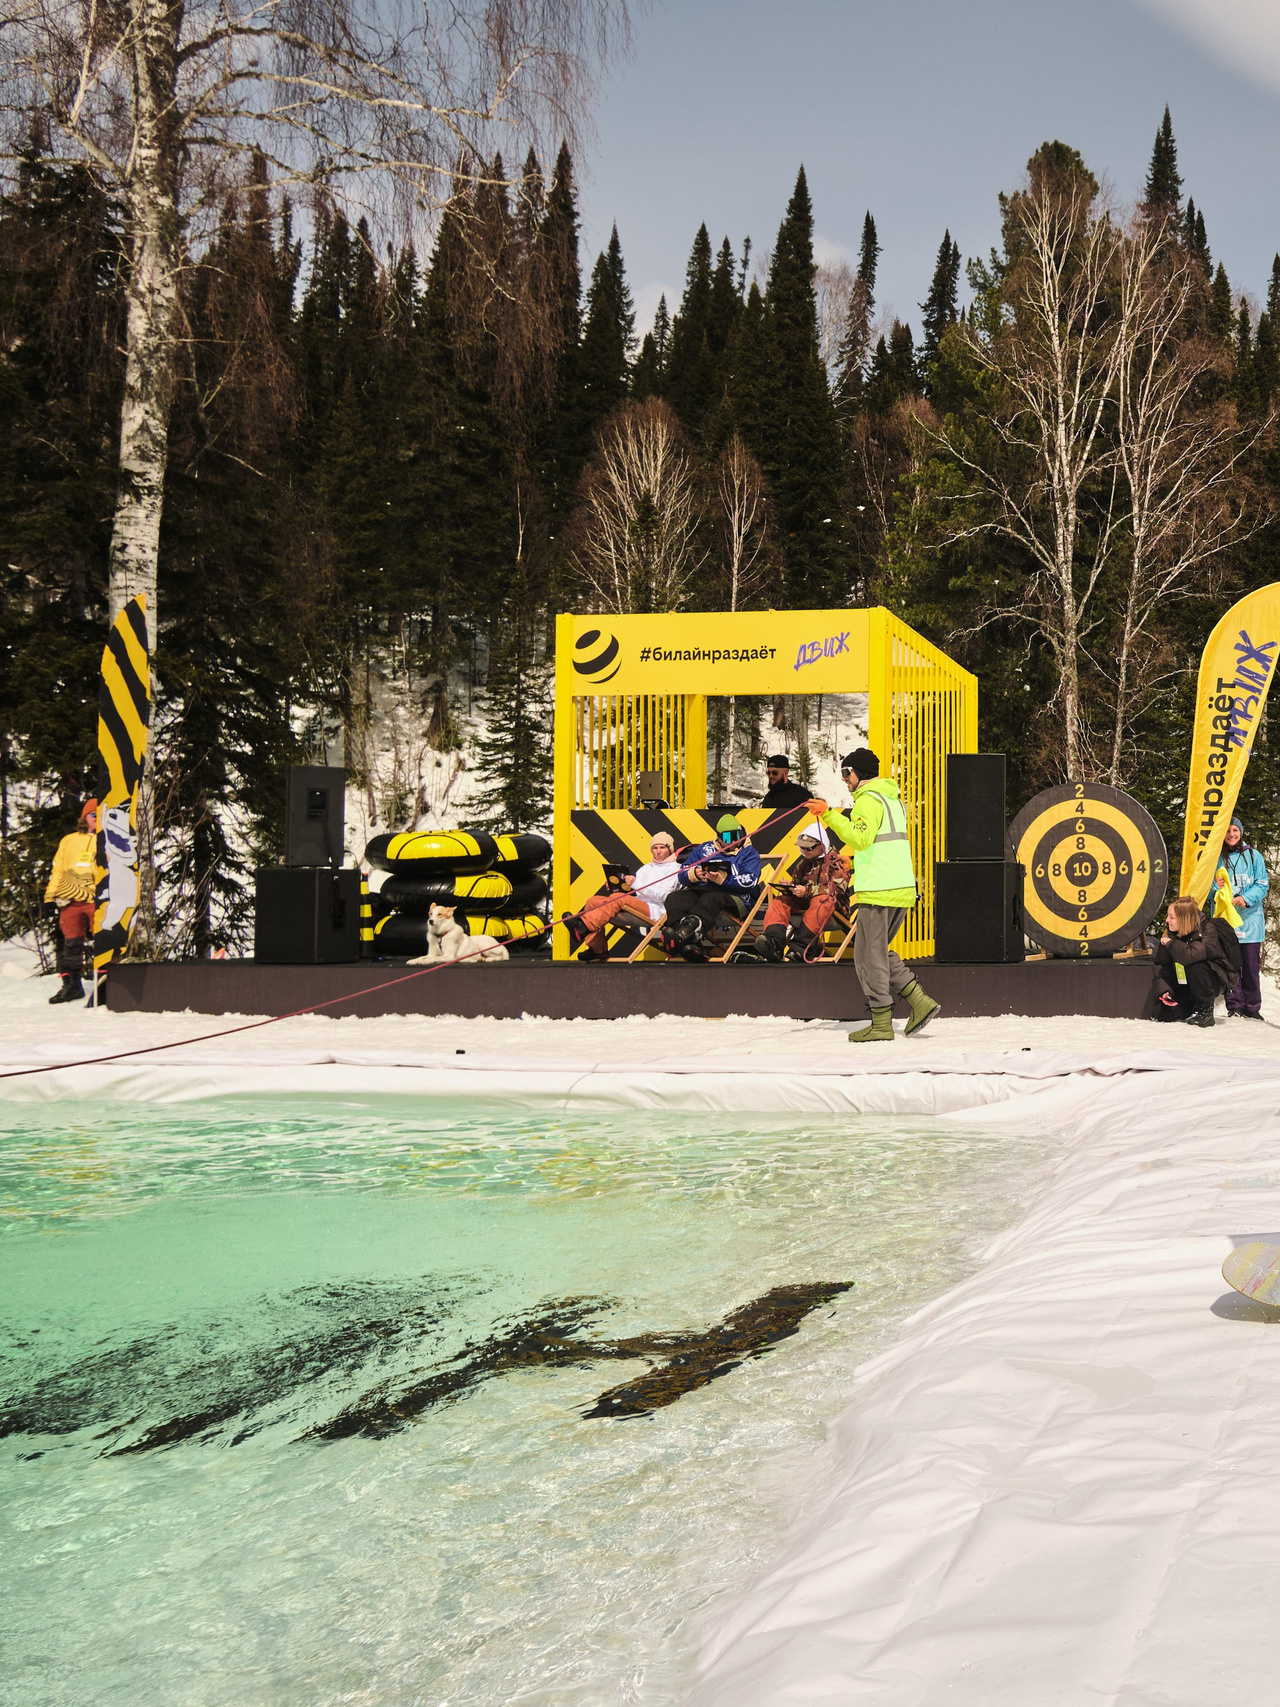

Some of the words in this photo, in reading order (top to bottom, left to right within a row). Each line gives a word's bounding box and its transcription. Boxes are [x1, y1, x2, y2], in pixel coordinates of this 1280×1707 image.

[639, 645, 777, 664] #билайнраздаёт
[793, 631, 851, 672] ДВИЖ
[1075, 783, 1085, 798] 2
[1075, 801, 1085, 815] 4
[1075, 819, 1085, 833] 6
[1076, 836, 1086, 850] 8
[1035, 864, 1045, 878] 6
[1052, 863, 1062, 877] 8
[1073, 862, 1092, 876] 10
[1102, 861, 1112, 875] 8
[1119, 860, 1129, 875] 6
[1136, 860, 1147, 873] 4
[1154, 859, 1163, 873] 2
[1077, 889, 1087, 903] 8
[1078, 907, 1088, 921] 6
[1079, 925, 1089, 938] 4
[1079, 942, 1089, 956] 2
